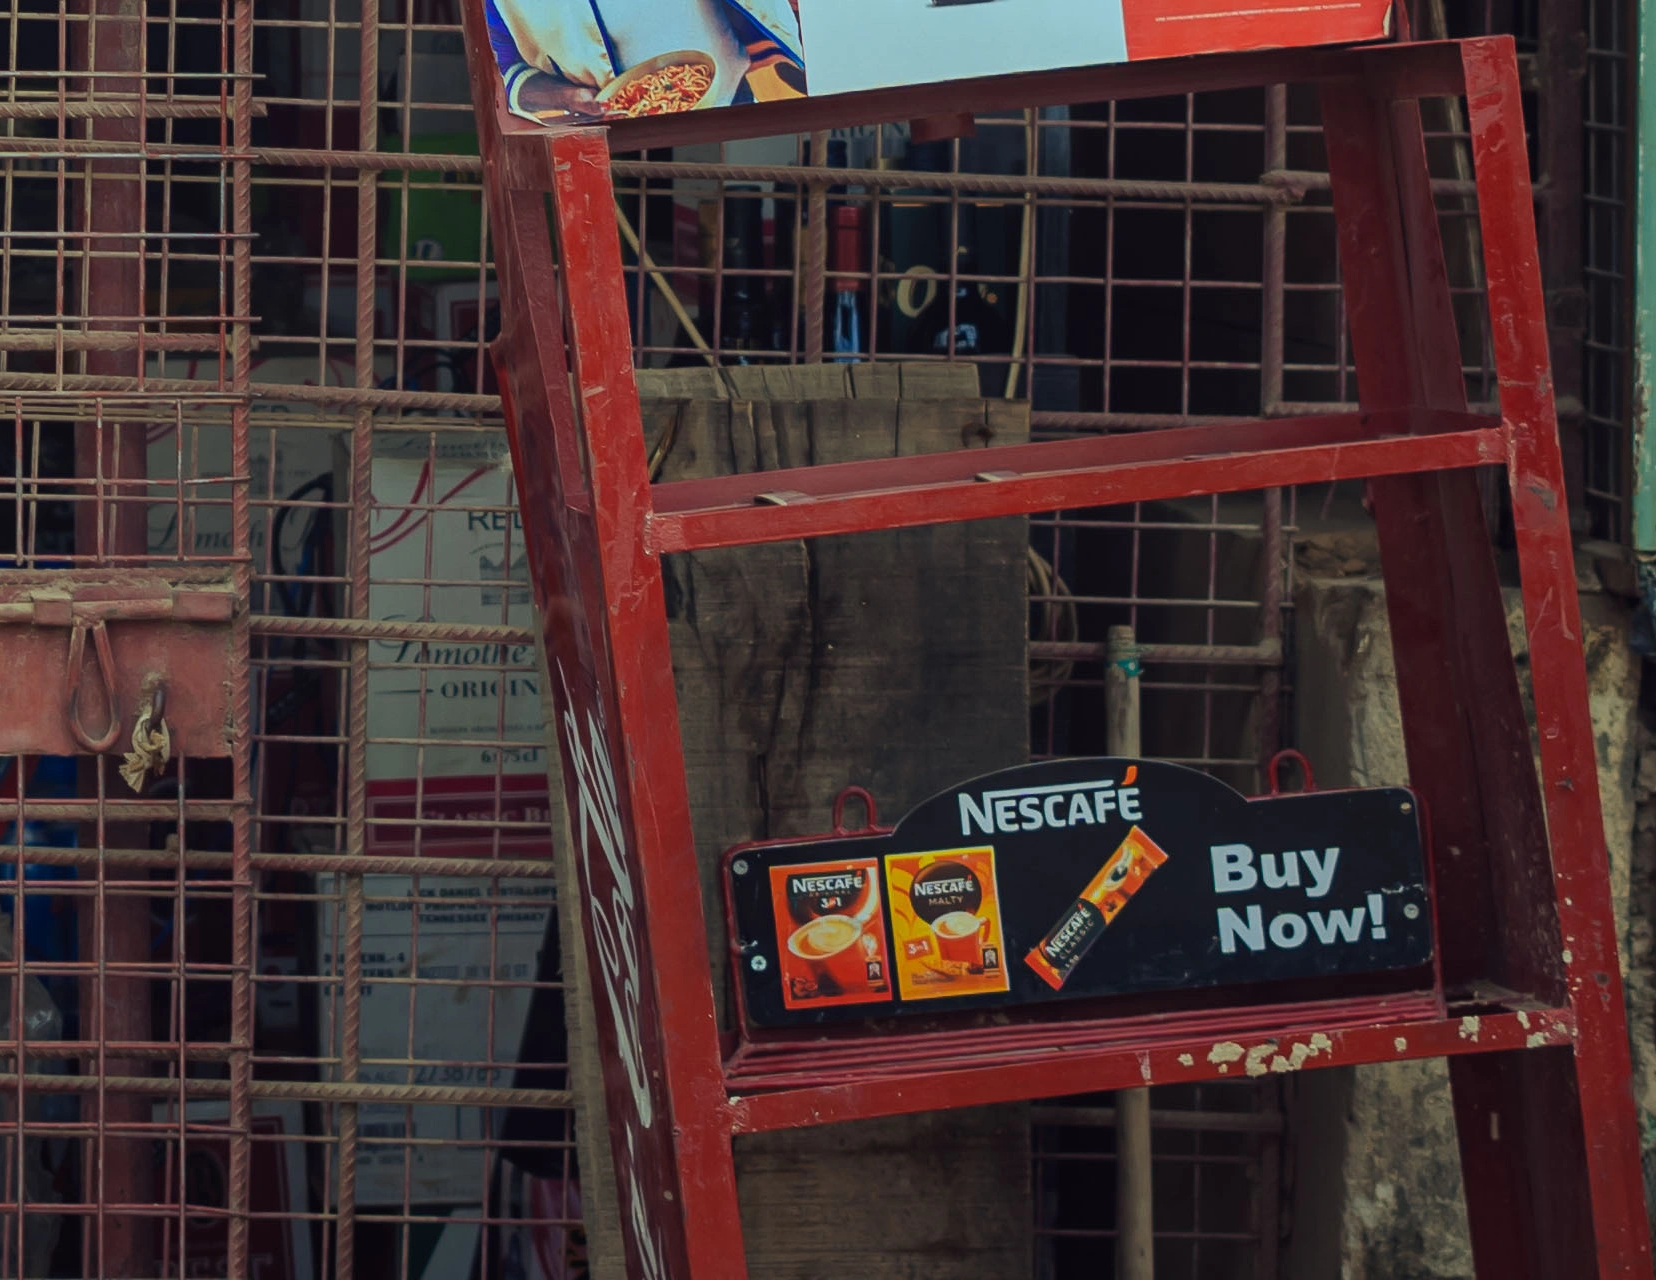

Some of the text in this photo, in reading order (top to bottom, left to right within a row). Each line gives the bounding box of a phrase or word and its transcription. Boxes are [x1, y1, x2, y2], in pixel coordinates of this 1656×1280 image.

[481, 748, 538, 764] 675cl
[958, 766, 1143, 836] NESCAFÉ
[1210, 841, 1340, 894] Buy
[928, 895, 964, 906] MALTY
[1218, 893, 1387, 956] Now!
